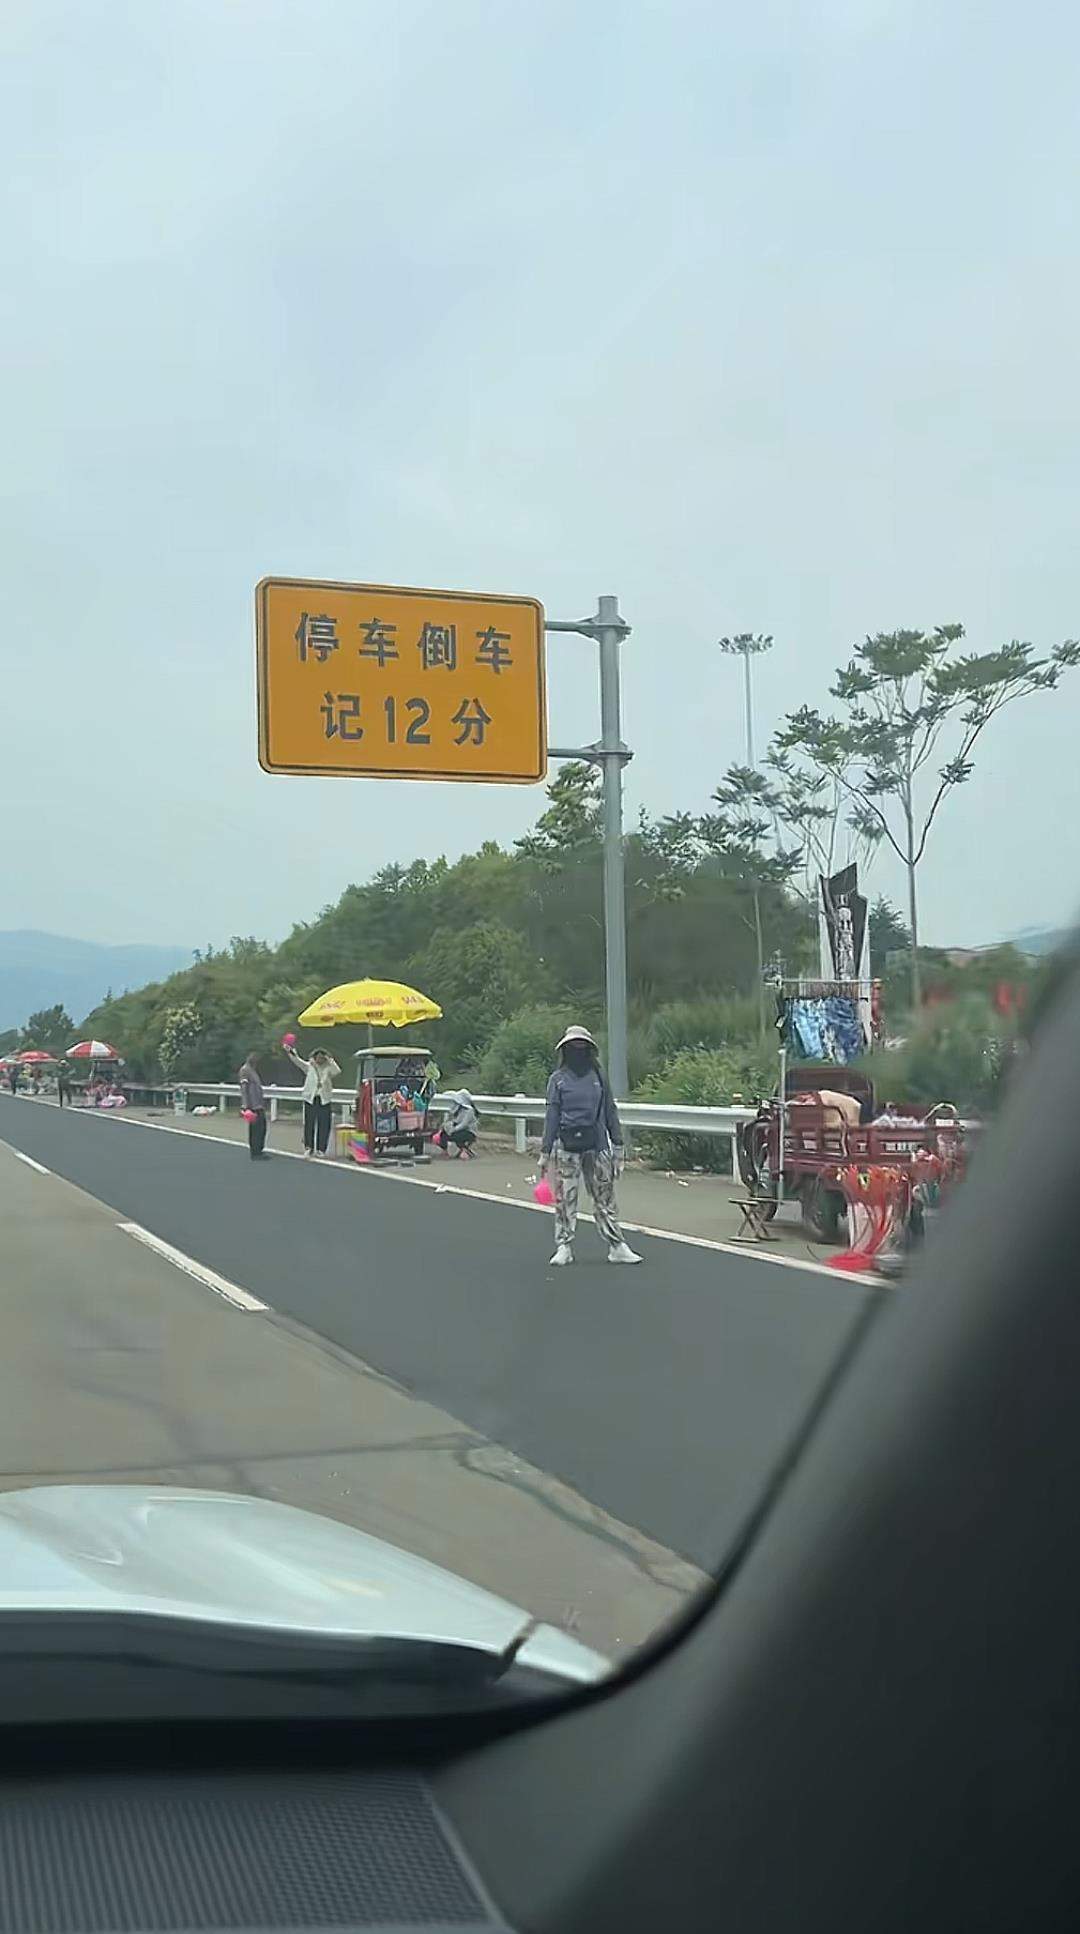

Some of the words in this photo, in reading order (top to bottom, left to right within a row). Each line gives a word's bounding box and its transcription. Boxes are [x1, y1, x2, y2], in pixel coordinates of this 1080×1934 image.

[295, 612, 514, 674] 停车倒车
[320, 691, 492, 746] 记12分
